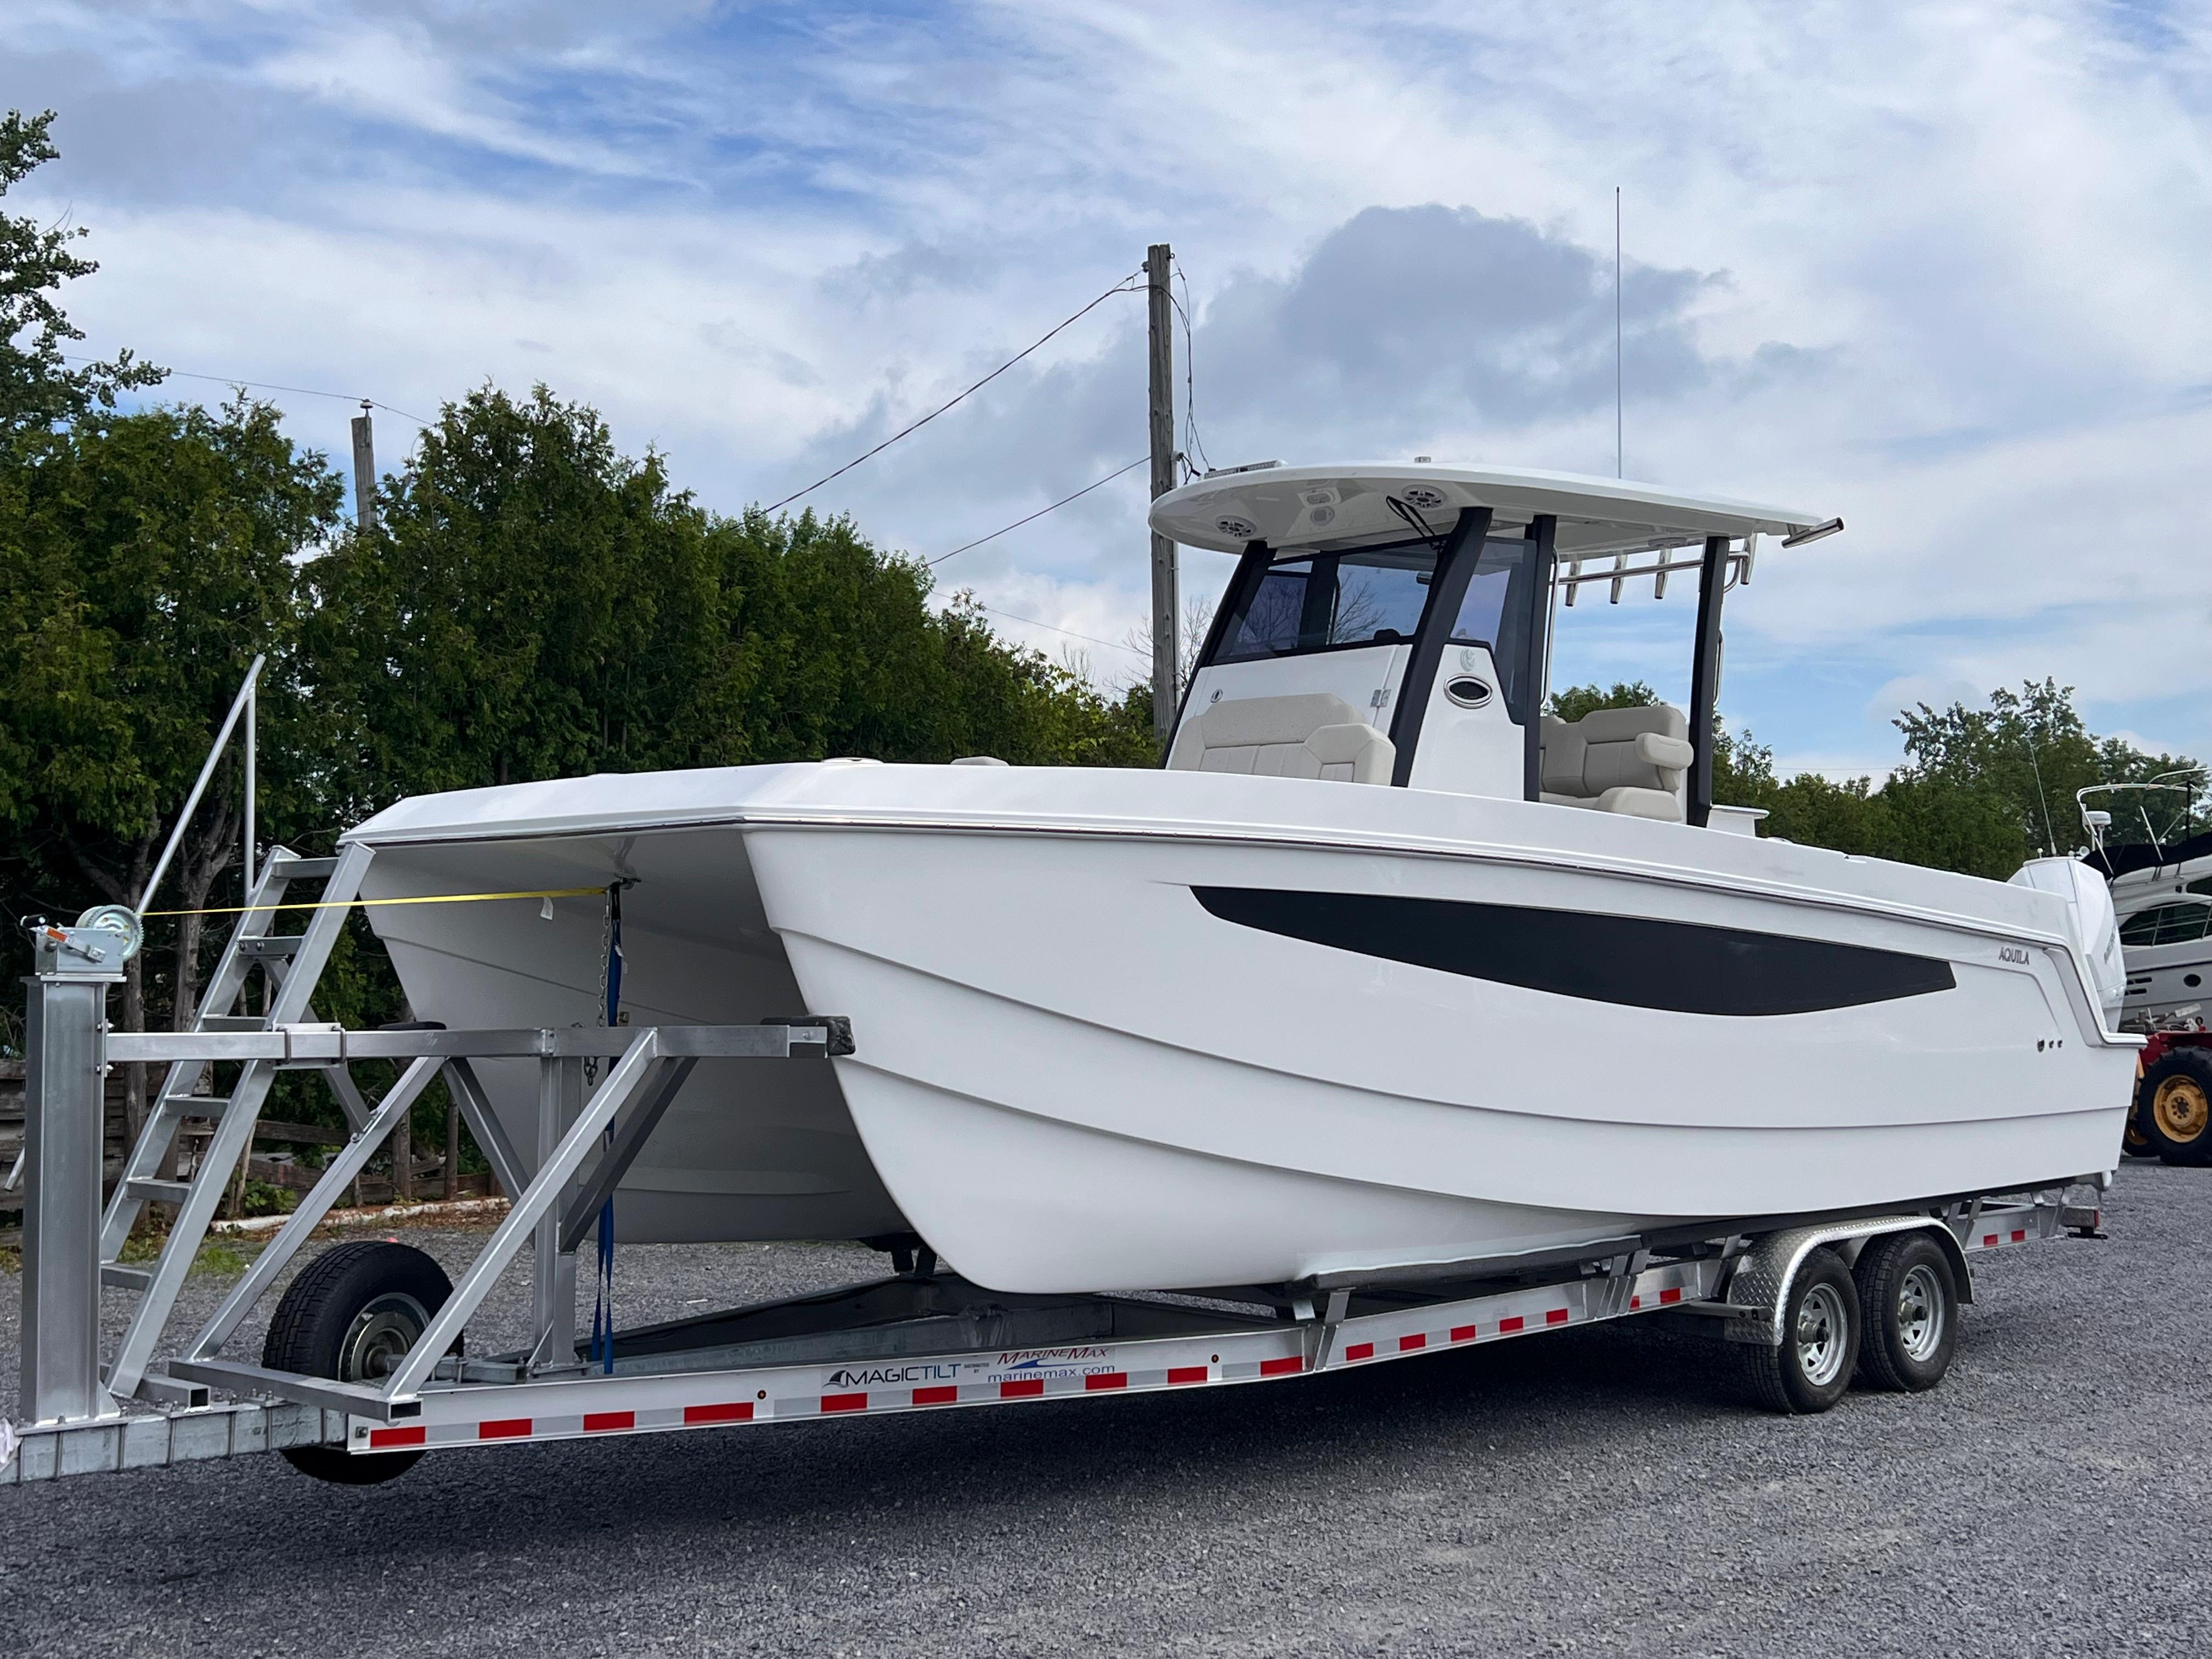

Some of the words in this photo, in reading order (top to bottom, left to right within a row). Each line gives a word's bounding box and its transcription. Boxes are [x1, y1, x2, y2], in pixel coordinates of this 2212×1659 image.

[1999, 946, 2029, 965] AQUILA
[845, 1363, 961, 1386] MAGICTILT
[988, 1365, 1115, 1383] marinemax.com
